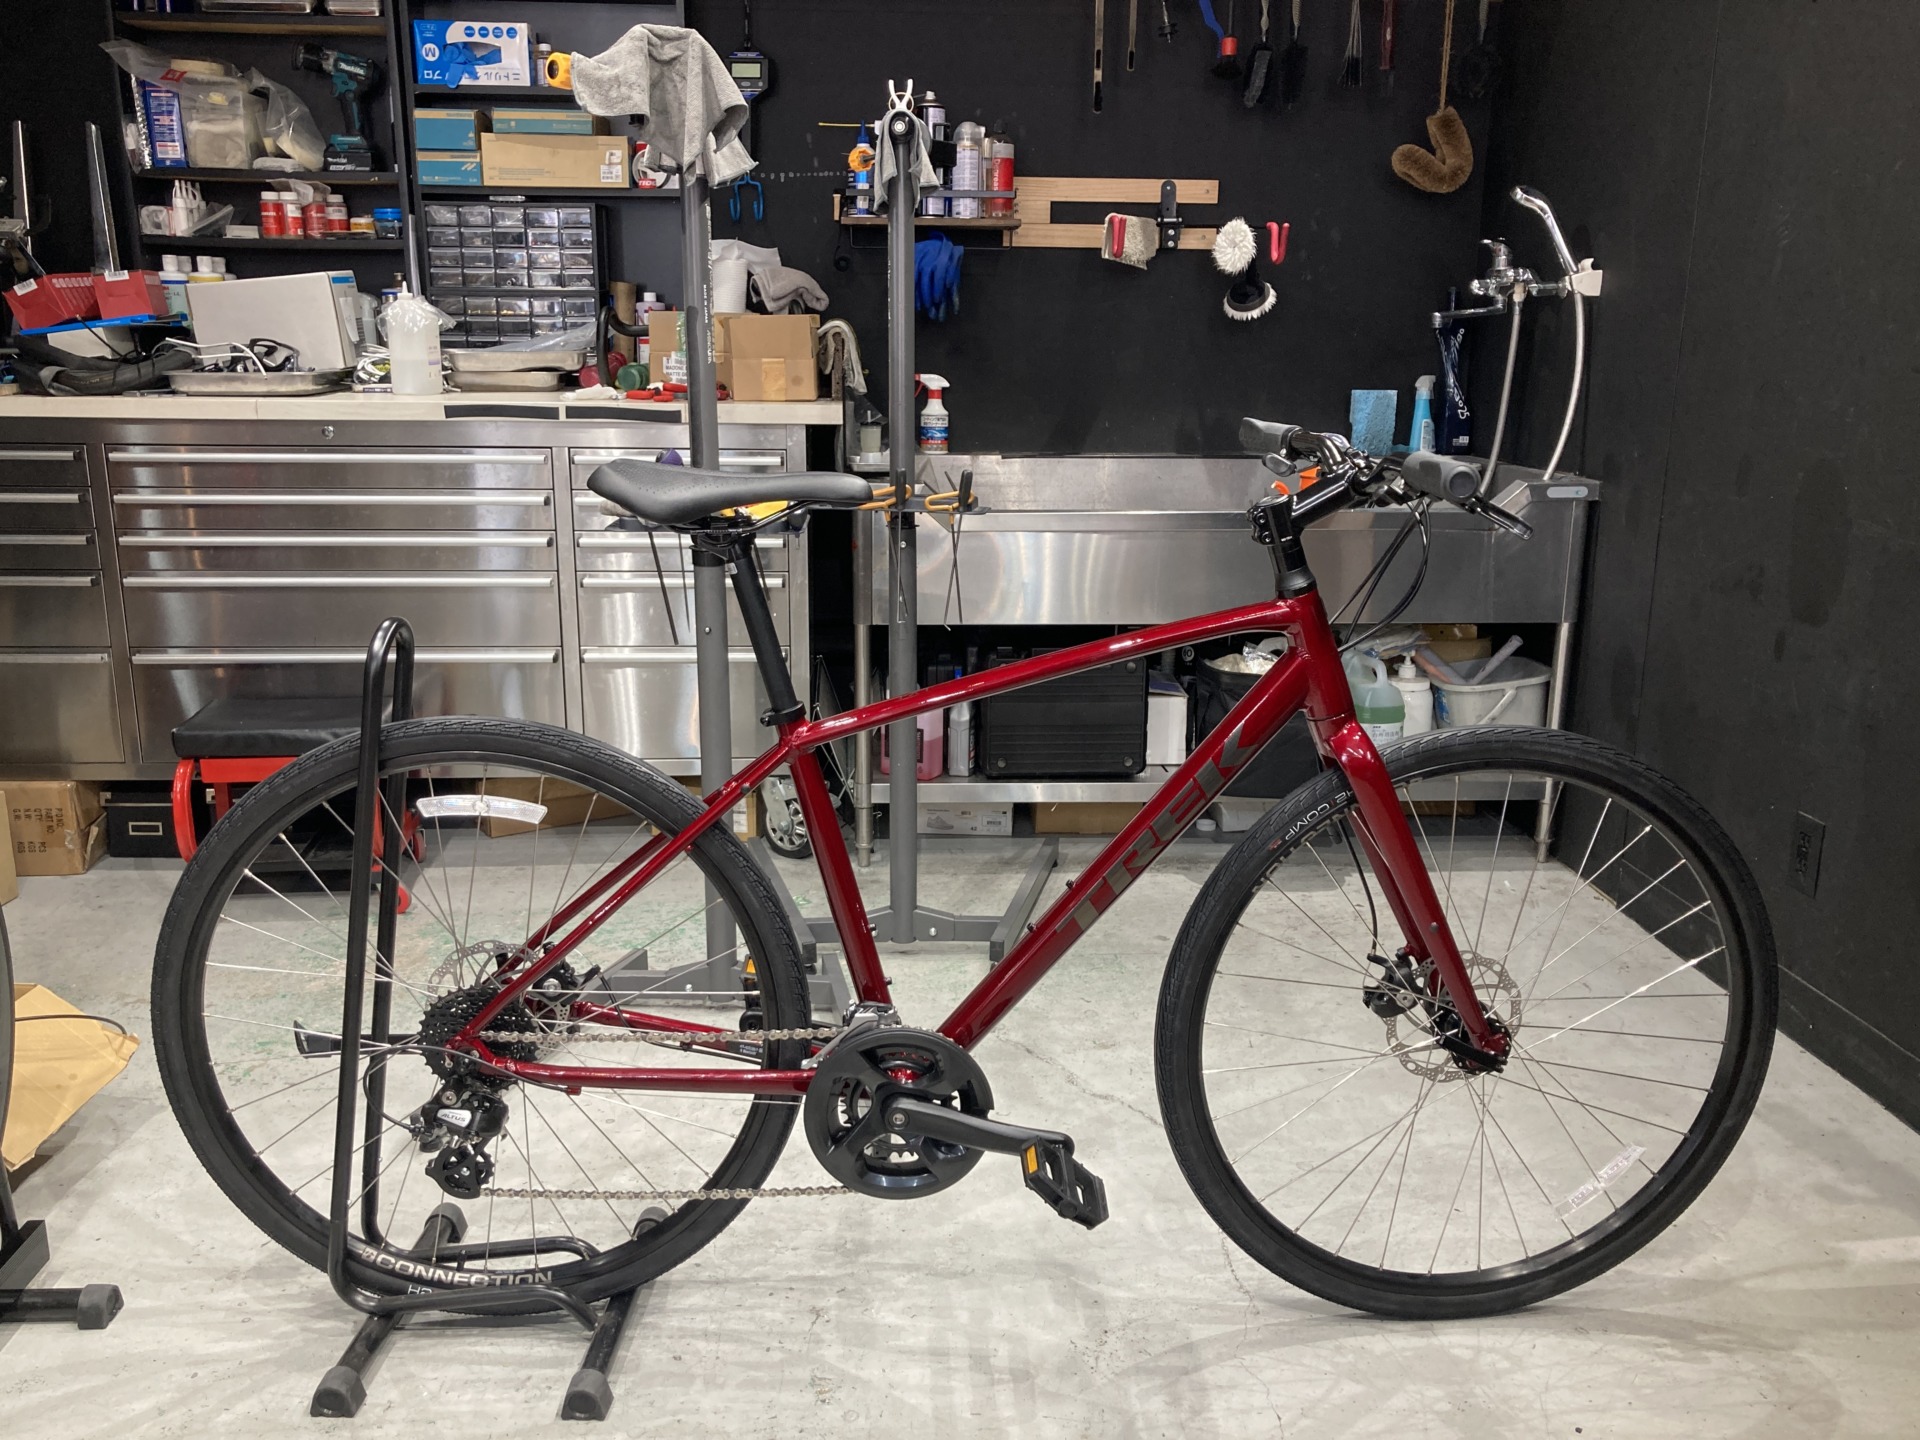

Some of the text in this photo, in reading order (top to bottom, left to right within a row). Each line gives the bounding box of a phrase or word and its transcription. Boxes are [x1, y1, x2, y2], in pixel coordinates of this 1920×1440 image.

[424, 47, 436, 58] M
[44, 808, 54, 823] PART
[1285, 803, 1330, 841] COMP
[1056, 720, 1260, 933] TREK
[16, 841, 26, 854] KGS
[27, 841, 36, 853] KGS
[38, 841, 47, 853] PCS
[441, 1113, 468, 1122] ALTUS
[375, 1252, 552, 1288] CONNECTION
